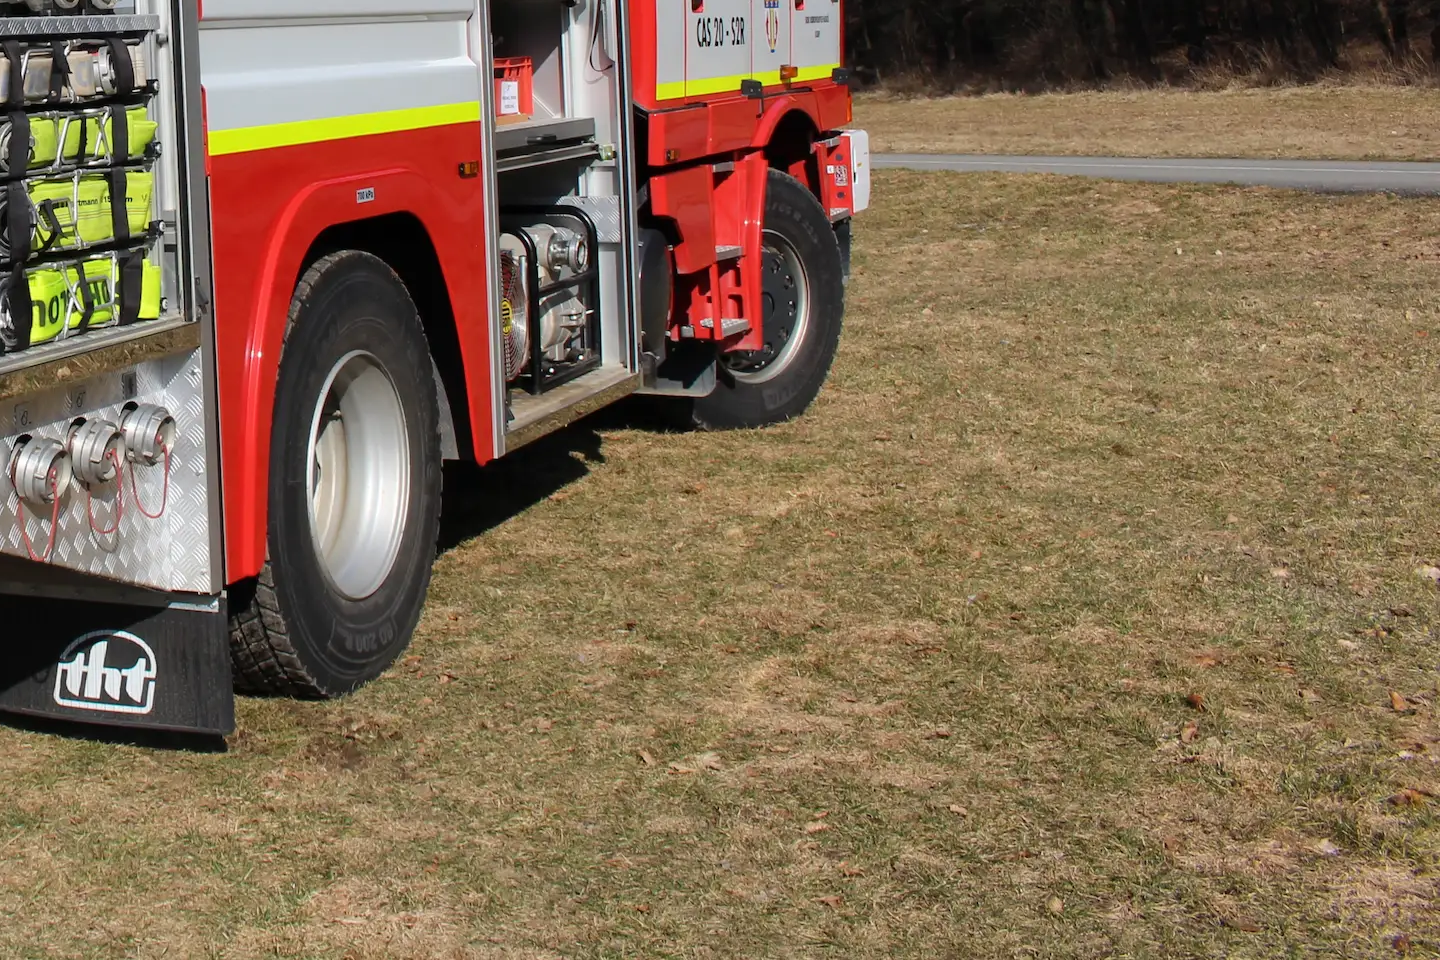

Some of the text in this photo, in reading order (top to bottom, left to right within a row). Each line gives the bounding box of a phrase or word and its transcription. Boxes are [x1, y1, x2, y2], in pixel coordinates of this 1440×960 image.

[697, 17, 711, 48] CAS
[713, 17, 723, 47] 20
[731, 17, 745, 46] S2R
